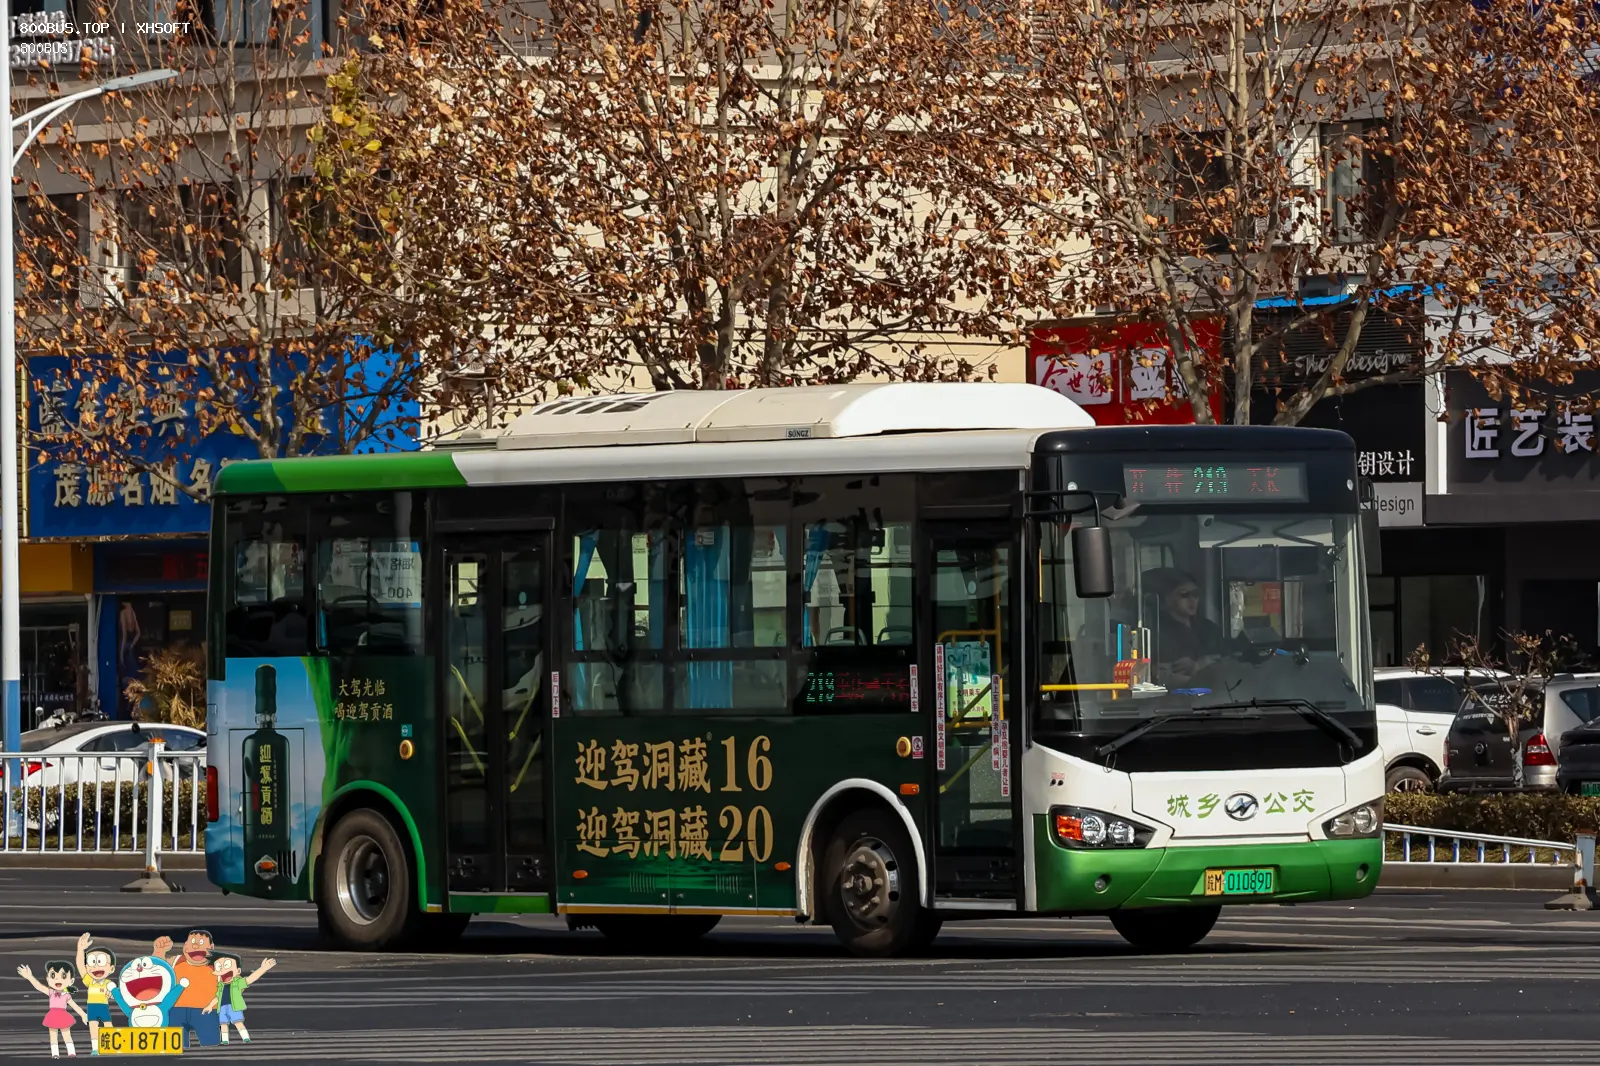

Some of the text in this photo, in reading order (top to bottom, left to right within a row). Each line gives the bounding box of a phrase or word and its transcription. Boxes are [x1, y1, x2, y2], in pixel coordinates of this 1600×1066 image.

[1357, 449, 1415, 476] 钥设计
[53, 457, 238, 508] 茂源名烟名
[338, 677, 386, 698] 大驾光临
[334, 701, 393, 721] 喝迎驾贡酒
[574, 735, 773, 794] 迎驾洞藏 16
[1167, 788, 1316, 819] 城乡 公交
[575, 805, 774, 863] 迎驾洞藏 20
